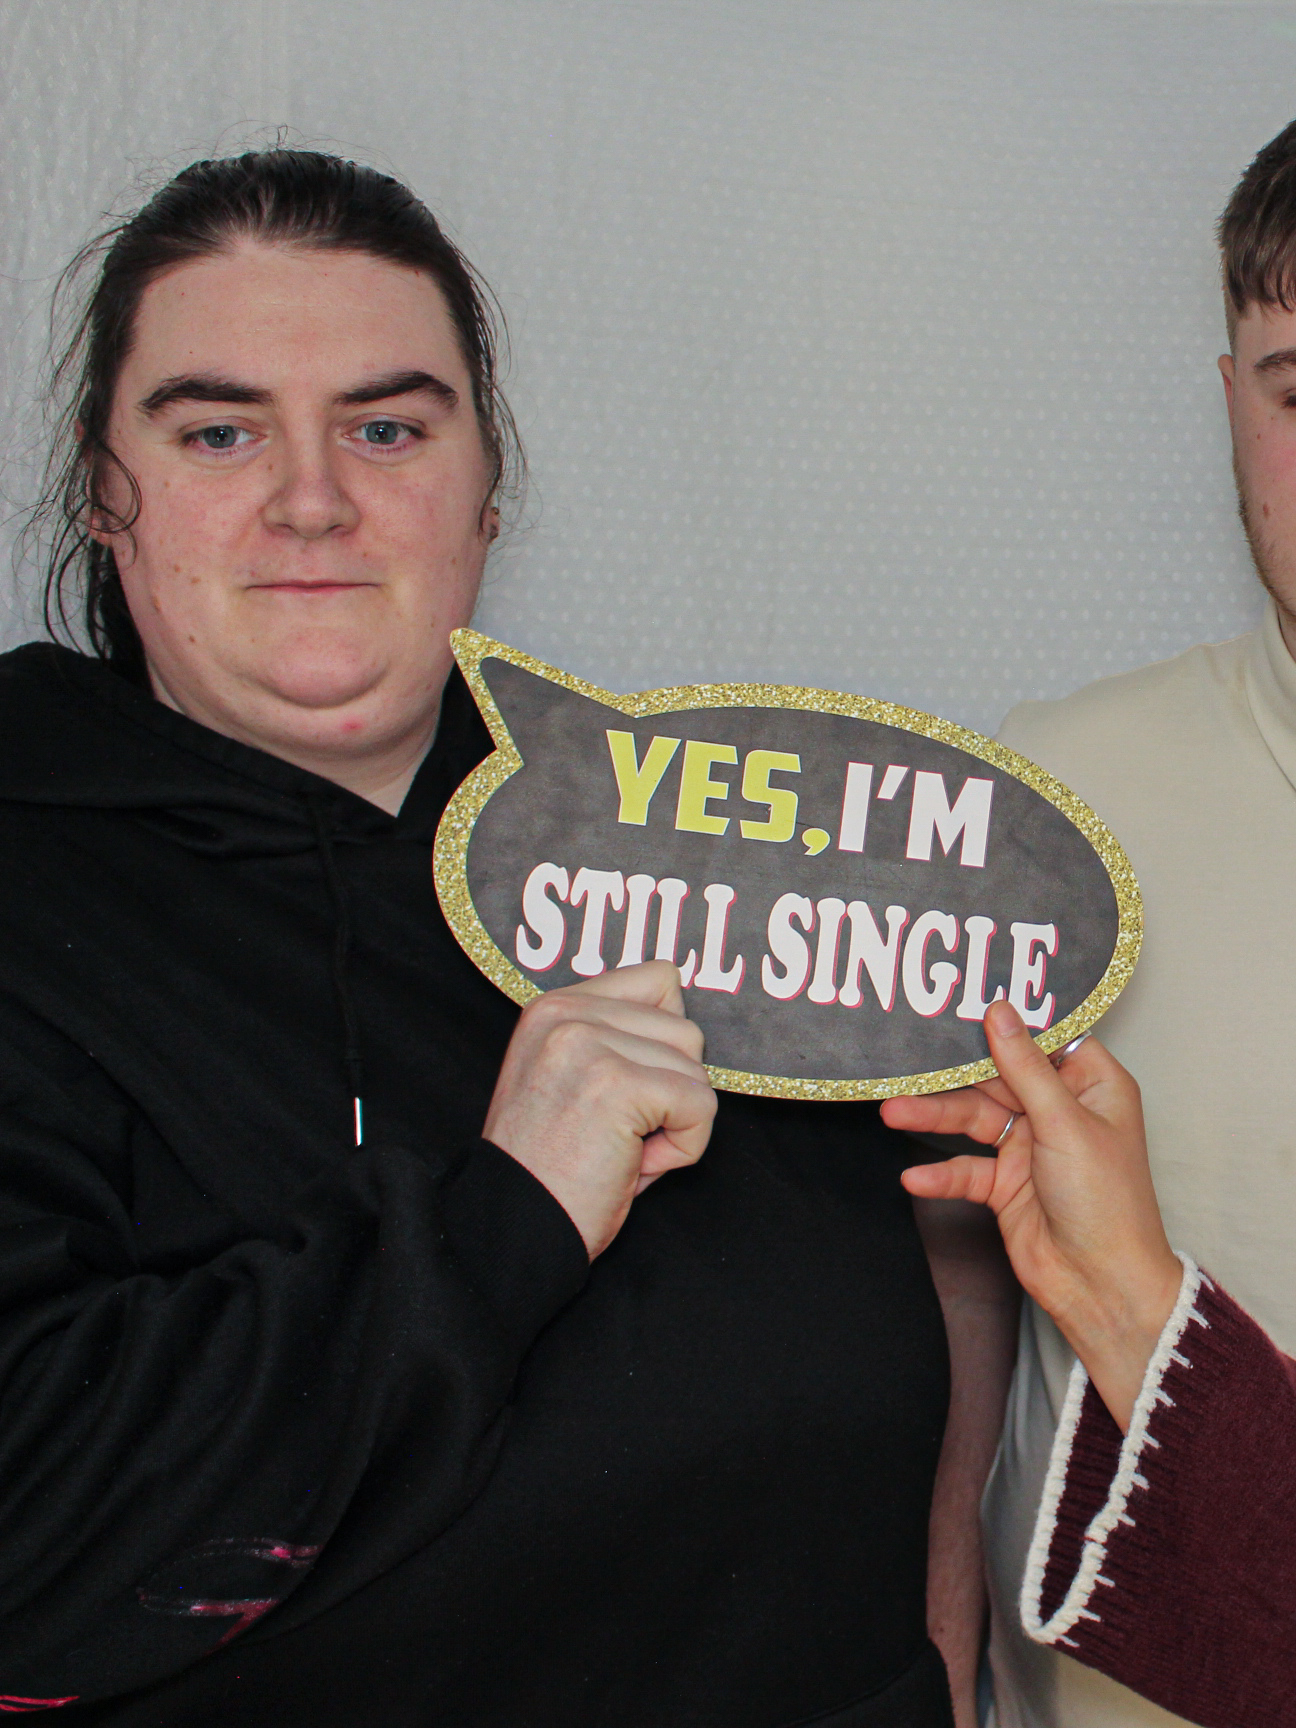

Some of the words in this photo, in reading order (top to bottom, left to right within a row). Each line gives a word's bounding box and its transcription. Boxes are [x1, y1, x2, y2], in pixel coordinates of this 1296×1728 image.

[605, 729, 831, 857] YES,
[838, 760, 994, 868] I'M
[515, 861, 744, 995] STILL
[761, 892, 1059, 1030] SINGLE
